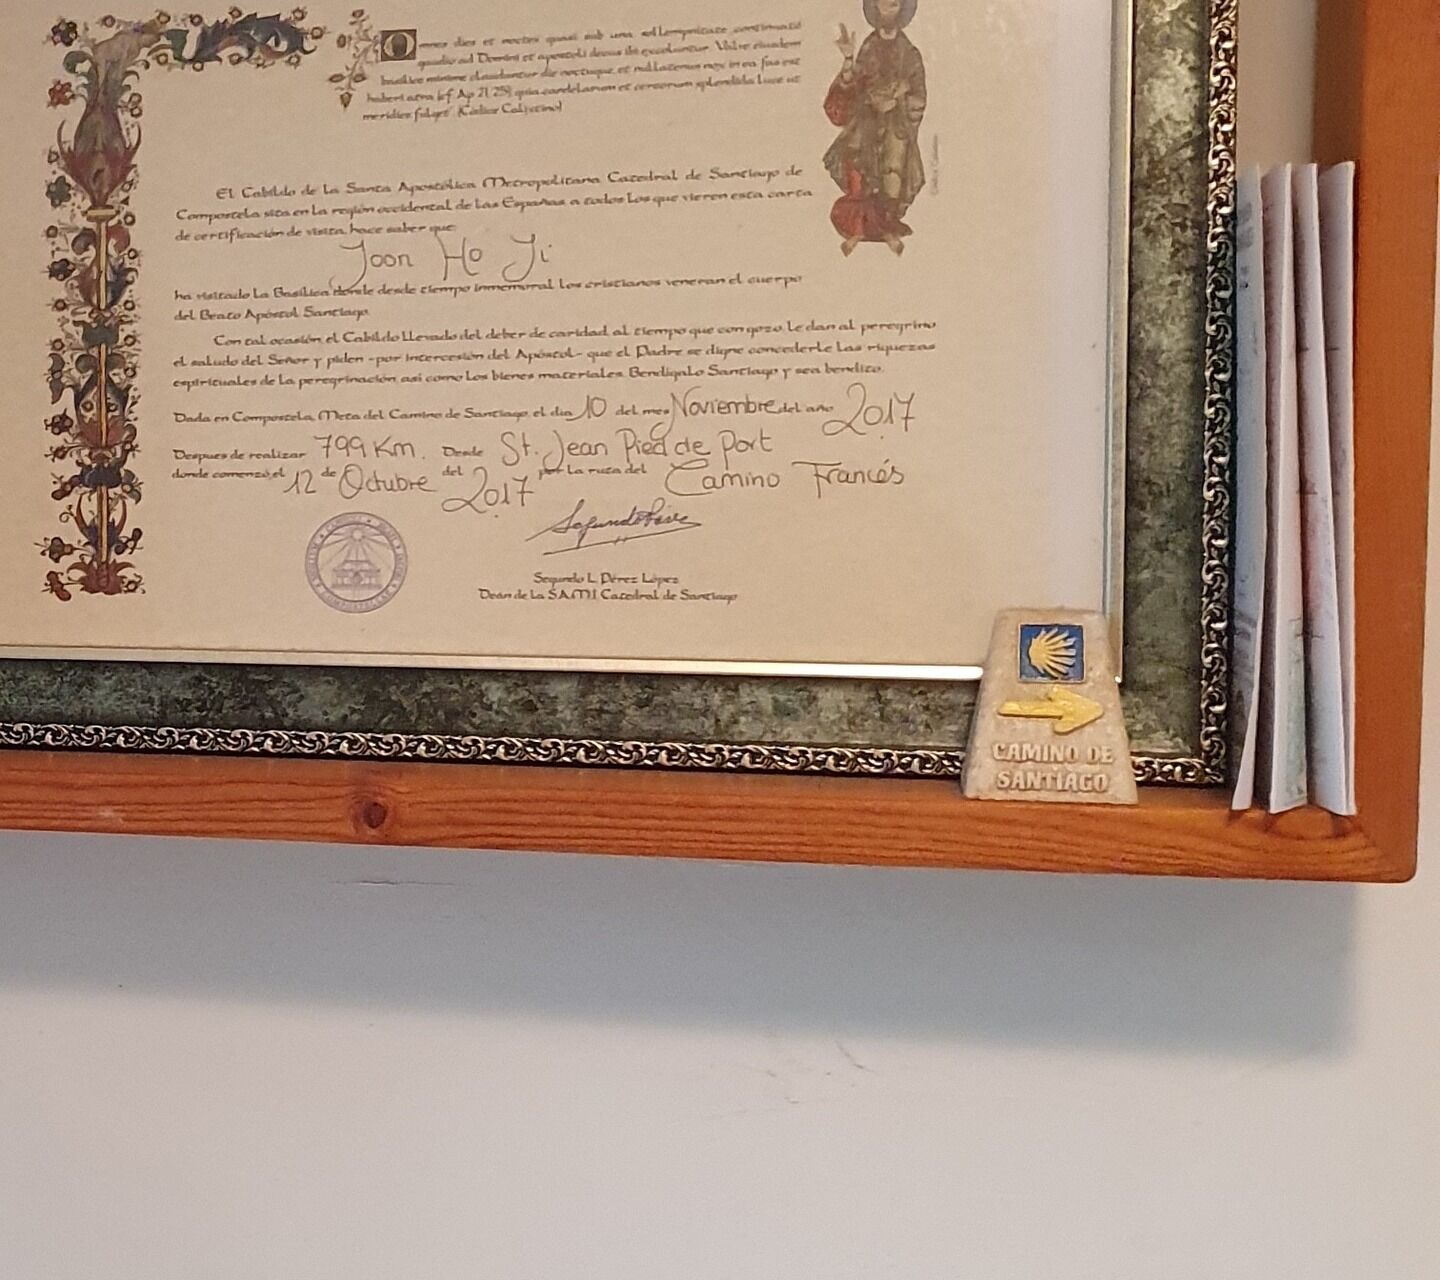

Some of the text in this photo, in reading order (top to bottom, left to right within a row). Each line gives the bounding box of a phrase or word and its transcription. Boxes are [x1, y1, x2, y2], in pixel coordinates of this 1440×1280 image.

[216, 165, 803, 200] El Cabildo de la Santa Metropolitana Catedral de Santiago de
[176, 208, 260, 225] Compostela
[293, 208, 309, 216] en
[312, 204, 327, 216] la
[377, 199, 452, 213] occidental
[457, 199, 472, 210] de
[475, 198, 499, 209] las
[569, 198, 580, 206] a
[584, 193, 624, 205] todos
[627, 192, 650, 204] los
[652, 194, 679, 207] que
[683, 193, 728, 201] vieren
[731, 190, 763, 200] esta
[767, 189, 813, 198] carta
[175, 230, 190, 241] de
[286, 226, 302, 237] de
[349, 224, 383, 234] hace
[386, 222, 426, 233] saber
[175, 290, 191, 300] ha
[196, 288, 250, 300] visitado
[253, 288, 269, 299] la
[377, 283, 416, 294] desde
[420, 284, 471, 298] tiempo
[474, 279, 553, 292] inmemorial
[560, 278, 581, 290] los
[585, 276, 661, 288] cristianos
[665, 276, 726, 286] veneran
[728, 272, 742, 285] el
[747, 275, 802, 289] cuerpo
[174, 310, 195, 321] del
[199, 309, 241, 320] Beato
[214, 335, 241, 346] Con
[244, 335, 265, 345] tal
[326, 332, 340, 343] el
[460, 328, 483, 340] del
[485, 328, 526, 340] deber
[529, 326, 545, 339] de
[548, 325, 609, 338] caridad
[612, 324, 630, 337] al
[633, 326, 686, 340] tiempo
[689, 326, 715, 338] que
[719, 325, 745, 335] con
[787, 321, 805, 334] le
[805, 320, 837, 333] dan
[838, 318, 855, 331] al
[860, 320, 937, 337] peregrino
[173, 356, 186, 367] el
[190, 355, 238, 367] saludo
[241, 355, 264, 366] del
[268, 354, 310, 366] Señor
[313, 357, 322, 368] y
[326, 353, 364, 369] piden
[487, 348, 510, 360] del
[587, 350, 612, 363] que
[616, 344, 632, 357] el
[636, 343, 683, 359] Padre
[686, 348, 702, 356] se
[747, 341, 832, 355] concederle
[836, 340, 862, 353] las
[866, 341, 936, 356] riquezas
[173, 375, 257, 392] espirituales
[259, 375, 275, 386] de
[279, 374, 295, 385] la
[425, 373, 463, 383] como
[465, 370, 488, 381] los
[491, 369, 535, 381] bienes
[538, 368, 624, 379] materiales
[707, 364, 780, 379] Santiago
[783, 367, 792, 379] y
[795, 366, 821, 376] sea
[173, 412, 210, 423] Dada
[214, 414, 229, 422] en
[318, 410, 360, 421] Meta
[363, 409, 384, 420] del
[388, 408, 443, 420] Camino
[445, 408, 461, 419] de
[463, 407, 529, 422] Santiago
[533, 406, 547, 417] el
[565, 395, 607, 421] 10
[615, 404, 636, 415] del
[642, 406, 670, 415] mes
[779, 403, 804, 414] del
[822, 382, 917, 436] 2017
[229, 449, 245, 460] de
[249, 449, 307, 459] realizar
[313, 435, 368, 459] 799
[441, 445, 484, 458] Desde
[542, 429, 608, 469] Jean
[616, 428, 669, 464] Pied
[674, 437, 711, 456] de
[718, 427, 774, 470] Port
[171, 468, 209, 480] donde
[273, 468, 285, 478] el
[283, 469, 317, 494] 12
[321, 467, 337, 478] de
[338, 463, 438, 500] Octubre
[441, 466, 463, 477] del
[567, 465, 588, 475] la
[624, 463, 647, 474] del
[664, 458, 781, 497] Camino
[791, 458, 905, 499] Francés
[441, 466, 534, 514] 2017
[512, 588, 738, 604] de la Catedral de Santiago
[991, 742, 1115, 764] CAMINO DE
[995, 770, 1109, 793] SANTIAGO
